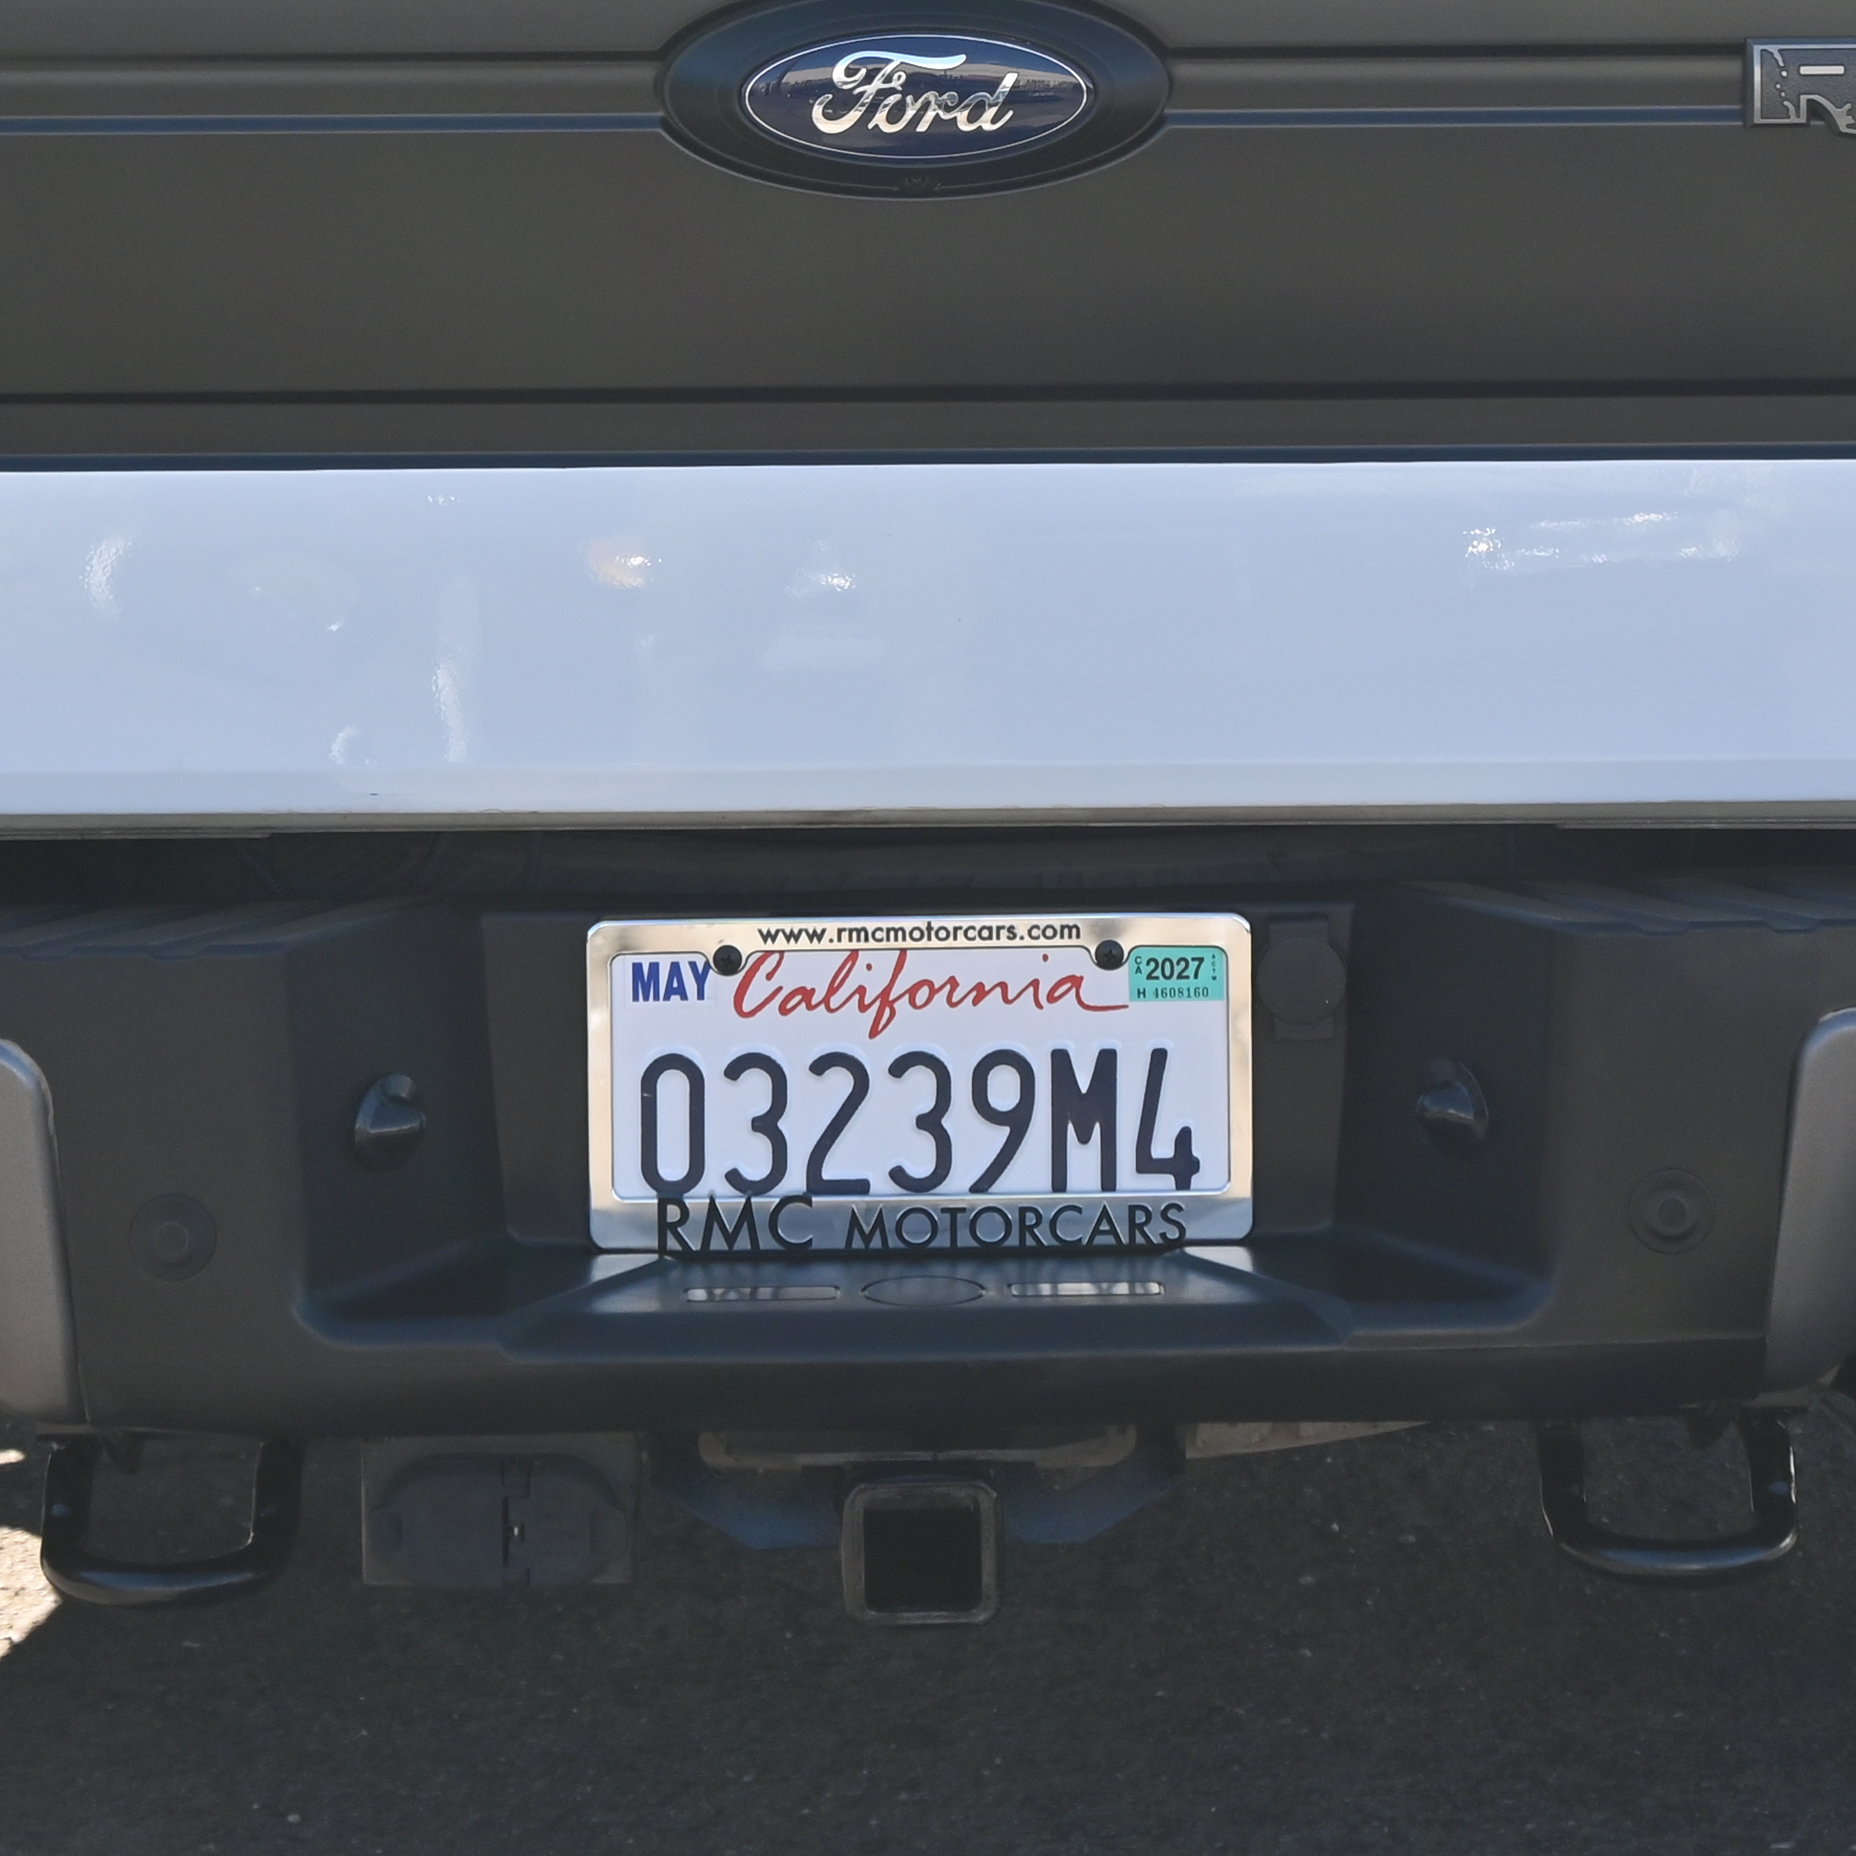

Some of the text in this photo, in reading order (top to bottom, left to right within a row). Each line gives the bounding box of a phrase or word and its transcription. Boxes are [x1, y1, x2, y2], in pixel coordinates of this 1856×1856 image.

[811, 50, 1019, 134] Ford
[757, 920, 1082, 945] www.rmcmotorcars.com
[631, 961, 711, 1002] MAY
[733, 950, 1129, 1040] California
[1137, 986, 1209, 999] H 4608160
[1145, 957, 1205, 981] 2027
[640, 1047, 1200, 1194] 03239M4
[656, 1191, 1188, 1254] RMC MOTORCARS
